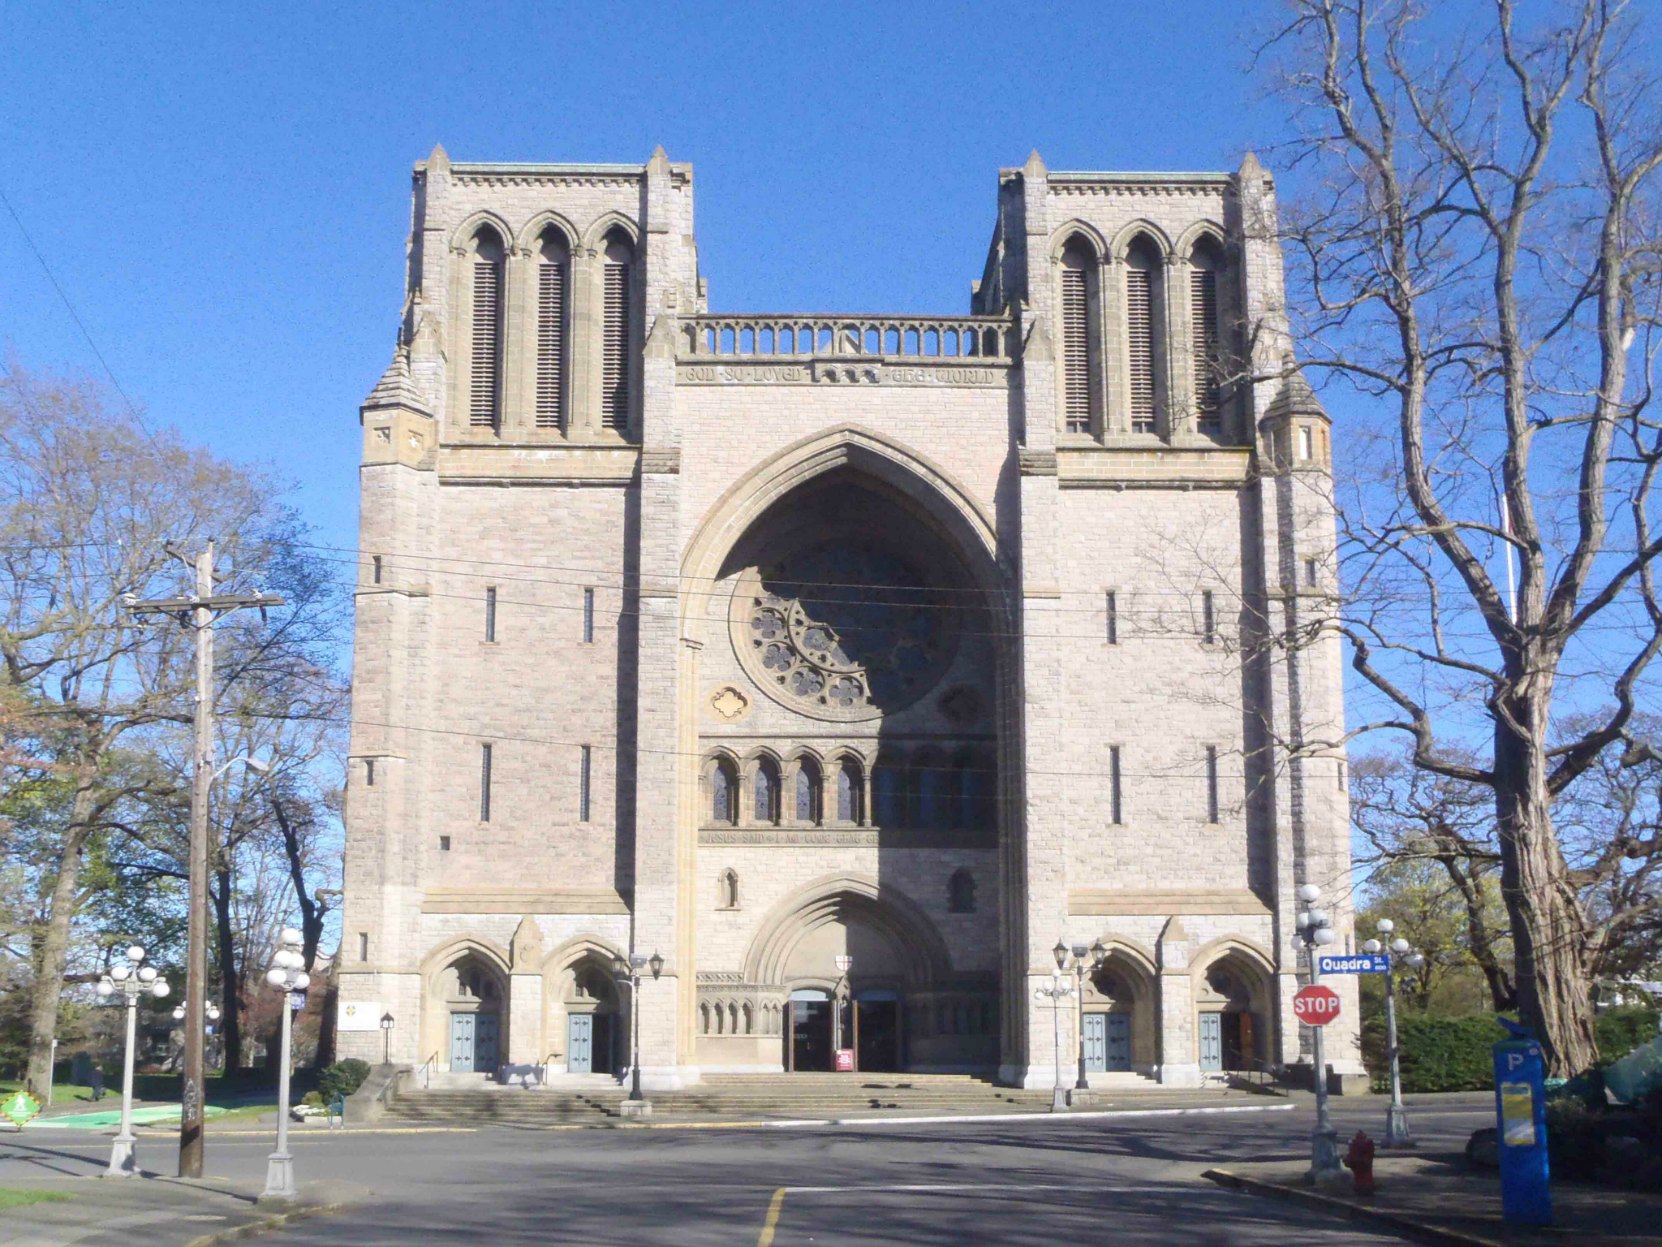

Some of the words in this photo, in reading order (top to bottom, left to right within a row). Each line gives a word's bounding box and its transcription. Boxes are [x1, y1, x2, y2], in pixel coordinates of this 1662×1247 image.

[685, 367, 714, 382] GOD
[724, 367, 743, 382] SO
[753, 367, 801, 382] LOVED
[891, 368, 926, 383] THE
[935, 368, 994, 384] WORLD
[1322, 958, 1371, 971] Quadra
[1295, 997, 1338, 1013] STOP
[1508, 1053, 1524, 1071] P
